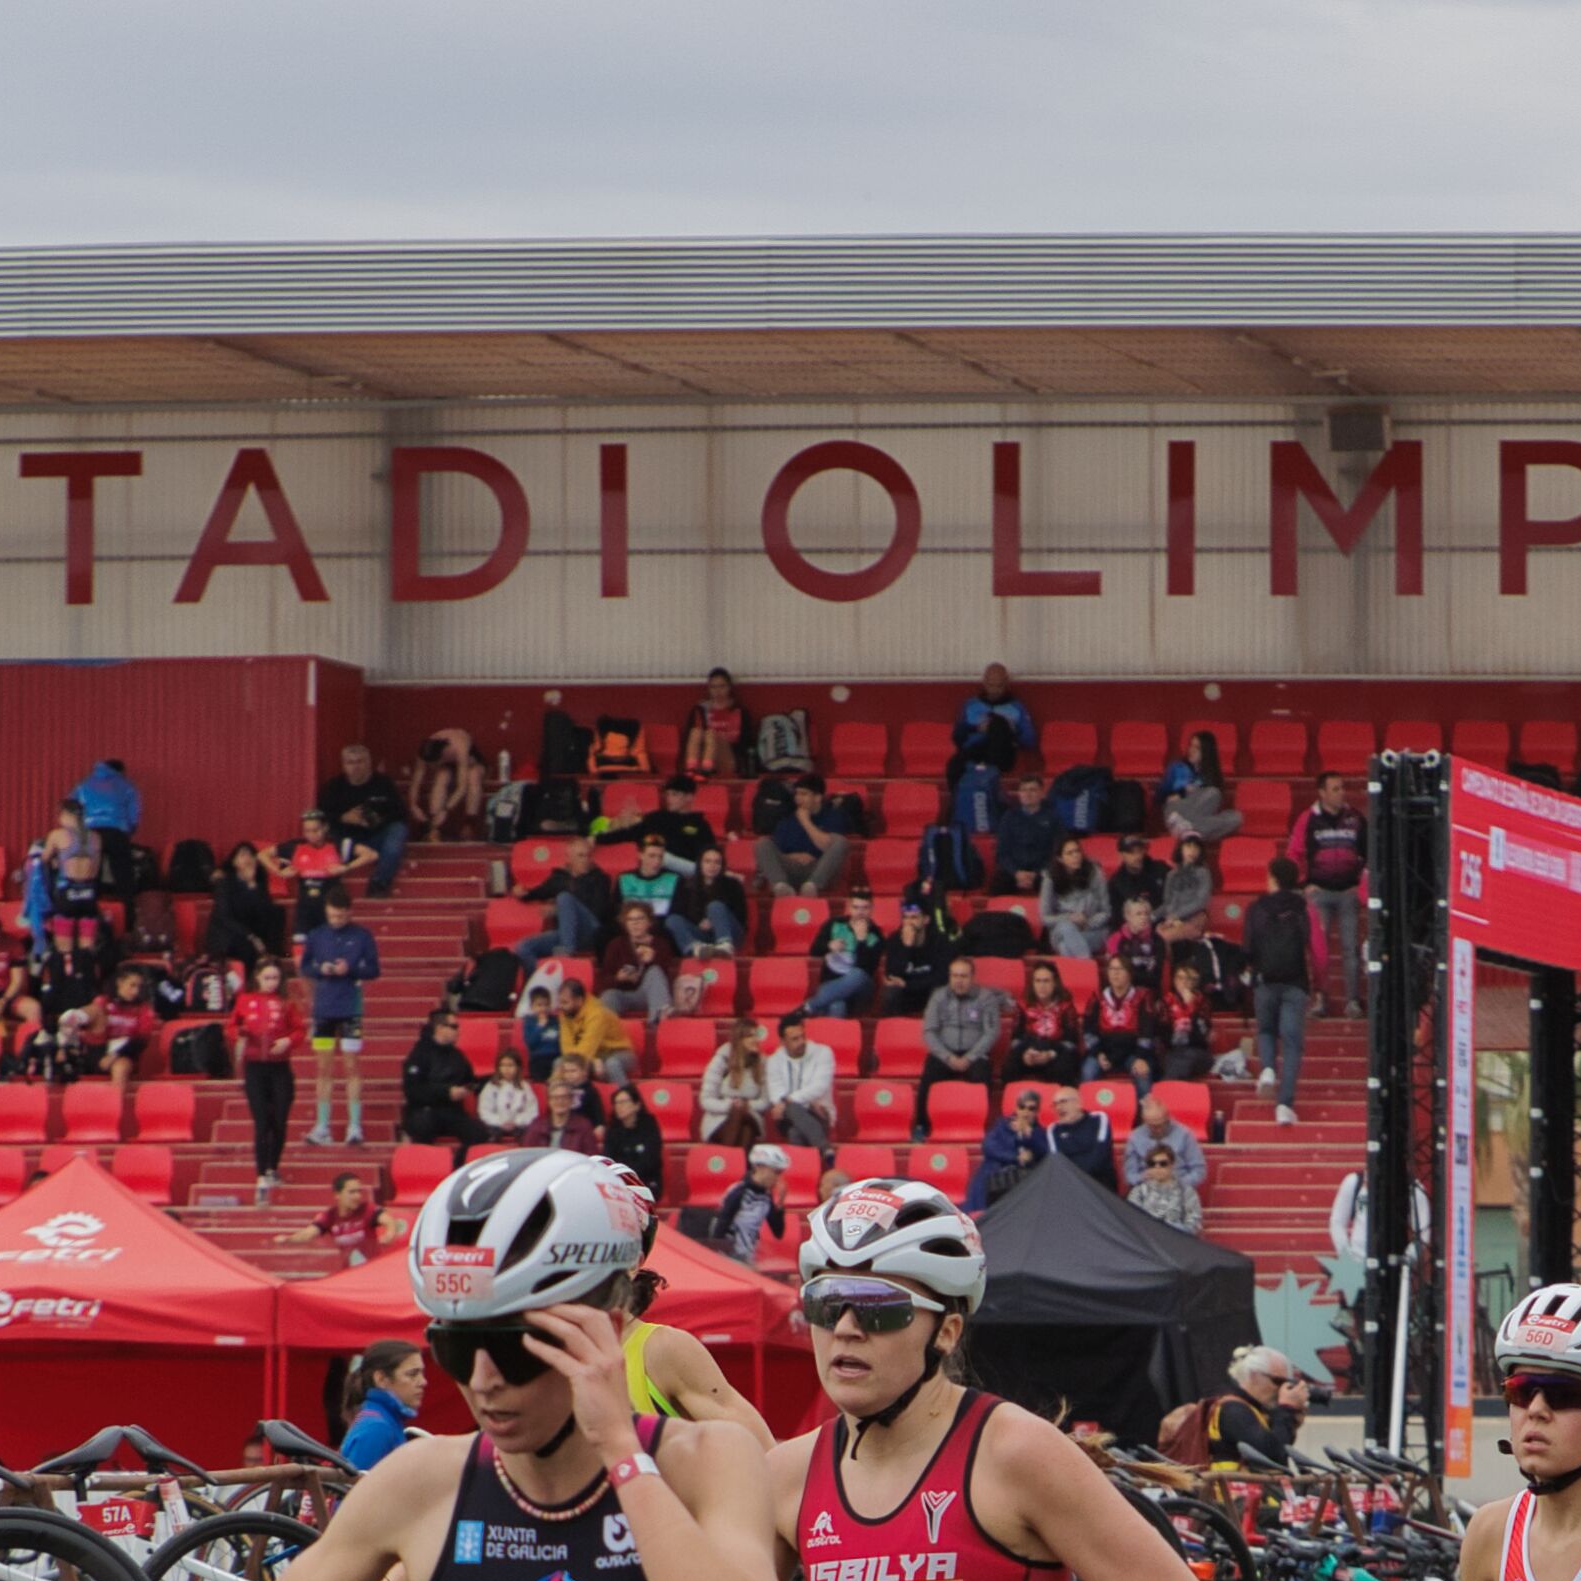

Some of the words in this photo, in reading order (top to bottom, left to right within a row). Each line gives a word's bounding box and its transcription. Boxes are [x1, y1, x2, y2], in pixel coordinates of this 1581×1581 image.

[845, 1203, 877, 1218] 58C
[434, 1273, 473, 1295] 55C
[1525, 1330, 1554, 1346] 56D
[102, 1504, 132, 1523] 57A
[486, 1525, 537, 1542] XUNTA
[485, 1544, 506, 1559] DE
[508, 1544, 568, 1561] GALICIA
